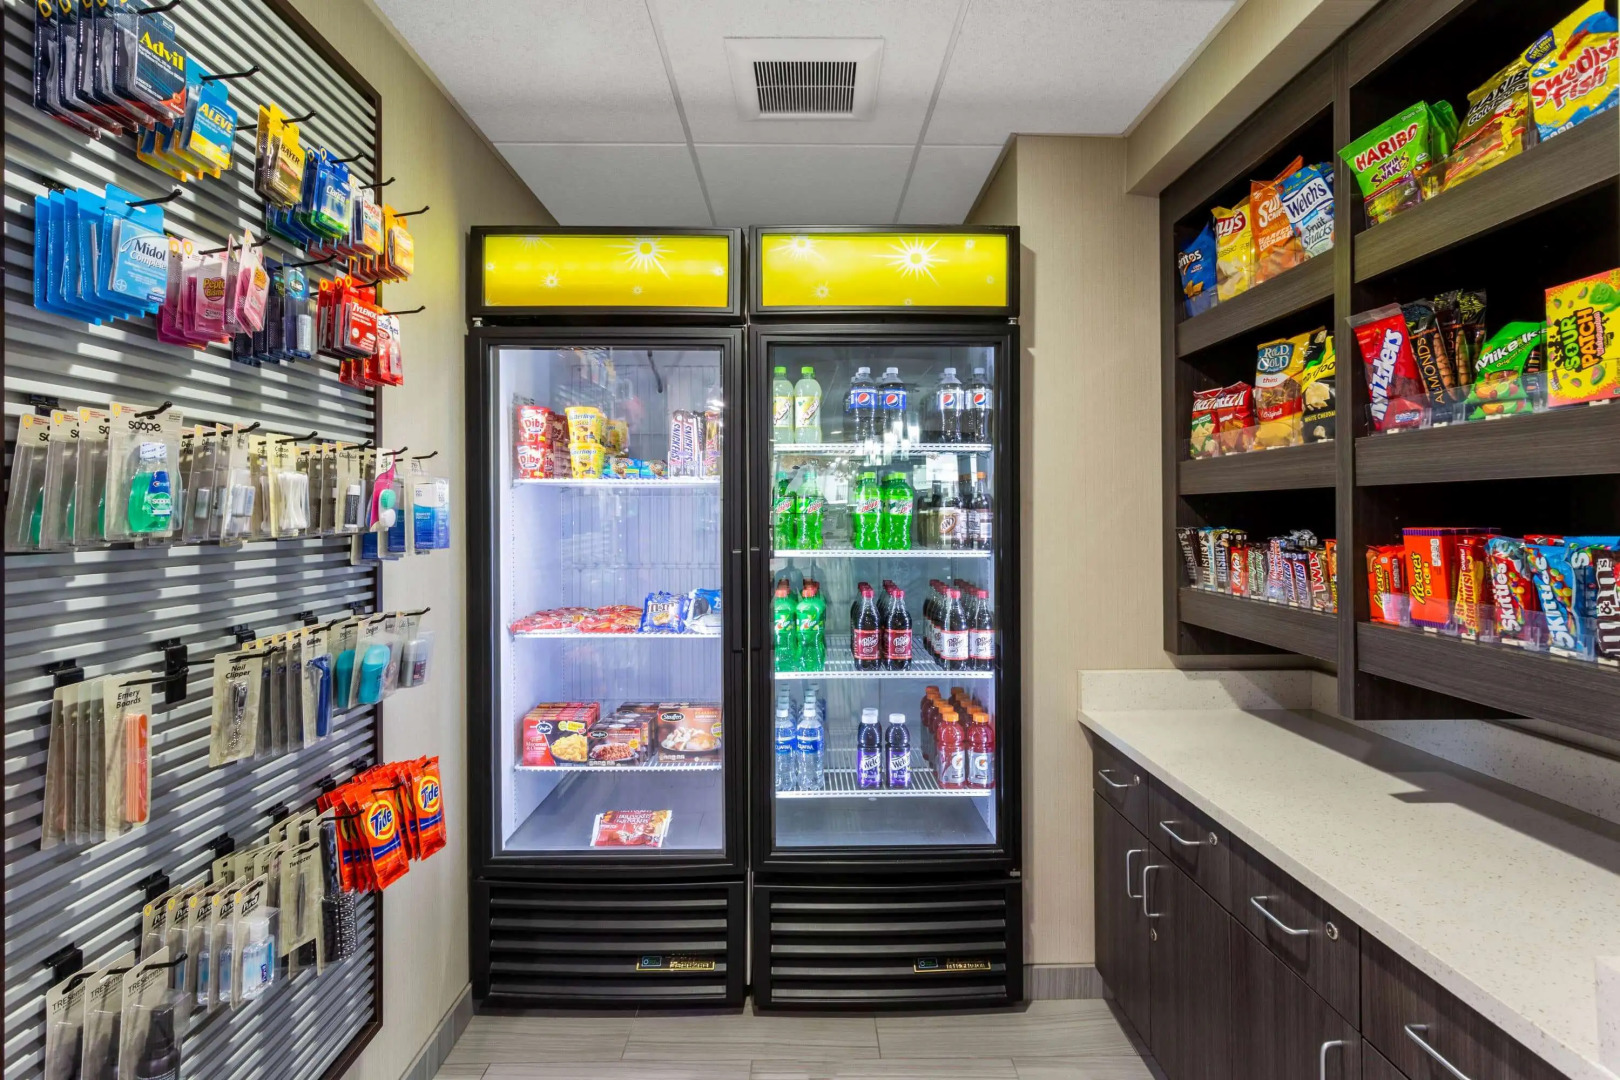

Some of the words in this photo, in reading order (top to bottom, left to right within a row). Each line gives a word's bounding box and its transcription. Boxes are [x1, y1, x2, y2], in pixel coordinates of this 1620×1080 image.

[139, 31, 184, 71] Advil
[1552, 64, 1609, 111] Fish
[198, 103, 235, 134] ALEVE
[281, 144, 300, 165] BAYER
[1355, 123, 1419, 172] HARIBO
[1378, 155, 1400, 172] TWIN
[1286, 182, 1327, 218] Welch's
[1303, 223, 1333, 247] Snacks
[1305, 216, 1325, 233] Fruit
[134, 239, 166, 261] Midol
[352, 302, 377, 319] TYLENOL
[1263, 344, 1290, 359] ROLD
[1560, 315, 1581, 371] SOUR
[1576, 307, 1601, 370] PATCH
[1257, 355, 1290, 371] GOLD
[1474, 339, 1519, 372] Mike
[1417, 337, 1446, 404] ALMONDS
[524, 418, 545, 429] Dibs
[520, 454, 540, 464] Dibs
[1309, 552, 1326, 597] TWIX
[1411, 552, 1426, 605] Reese's
[1496, 562, 1521, 632] Skittles
[1535, 556, 1575, 649] Skittles
[225, 669, 251, 679] Clipper
[231, 663, 246, 672] Nail
[116, 697, 141, 709] Boards
[117, 689, 140, 701] Emery
[421, 783, 439, 809] Tide
[370, 807, 392, 836] Tide
